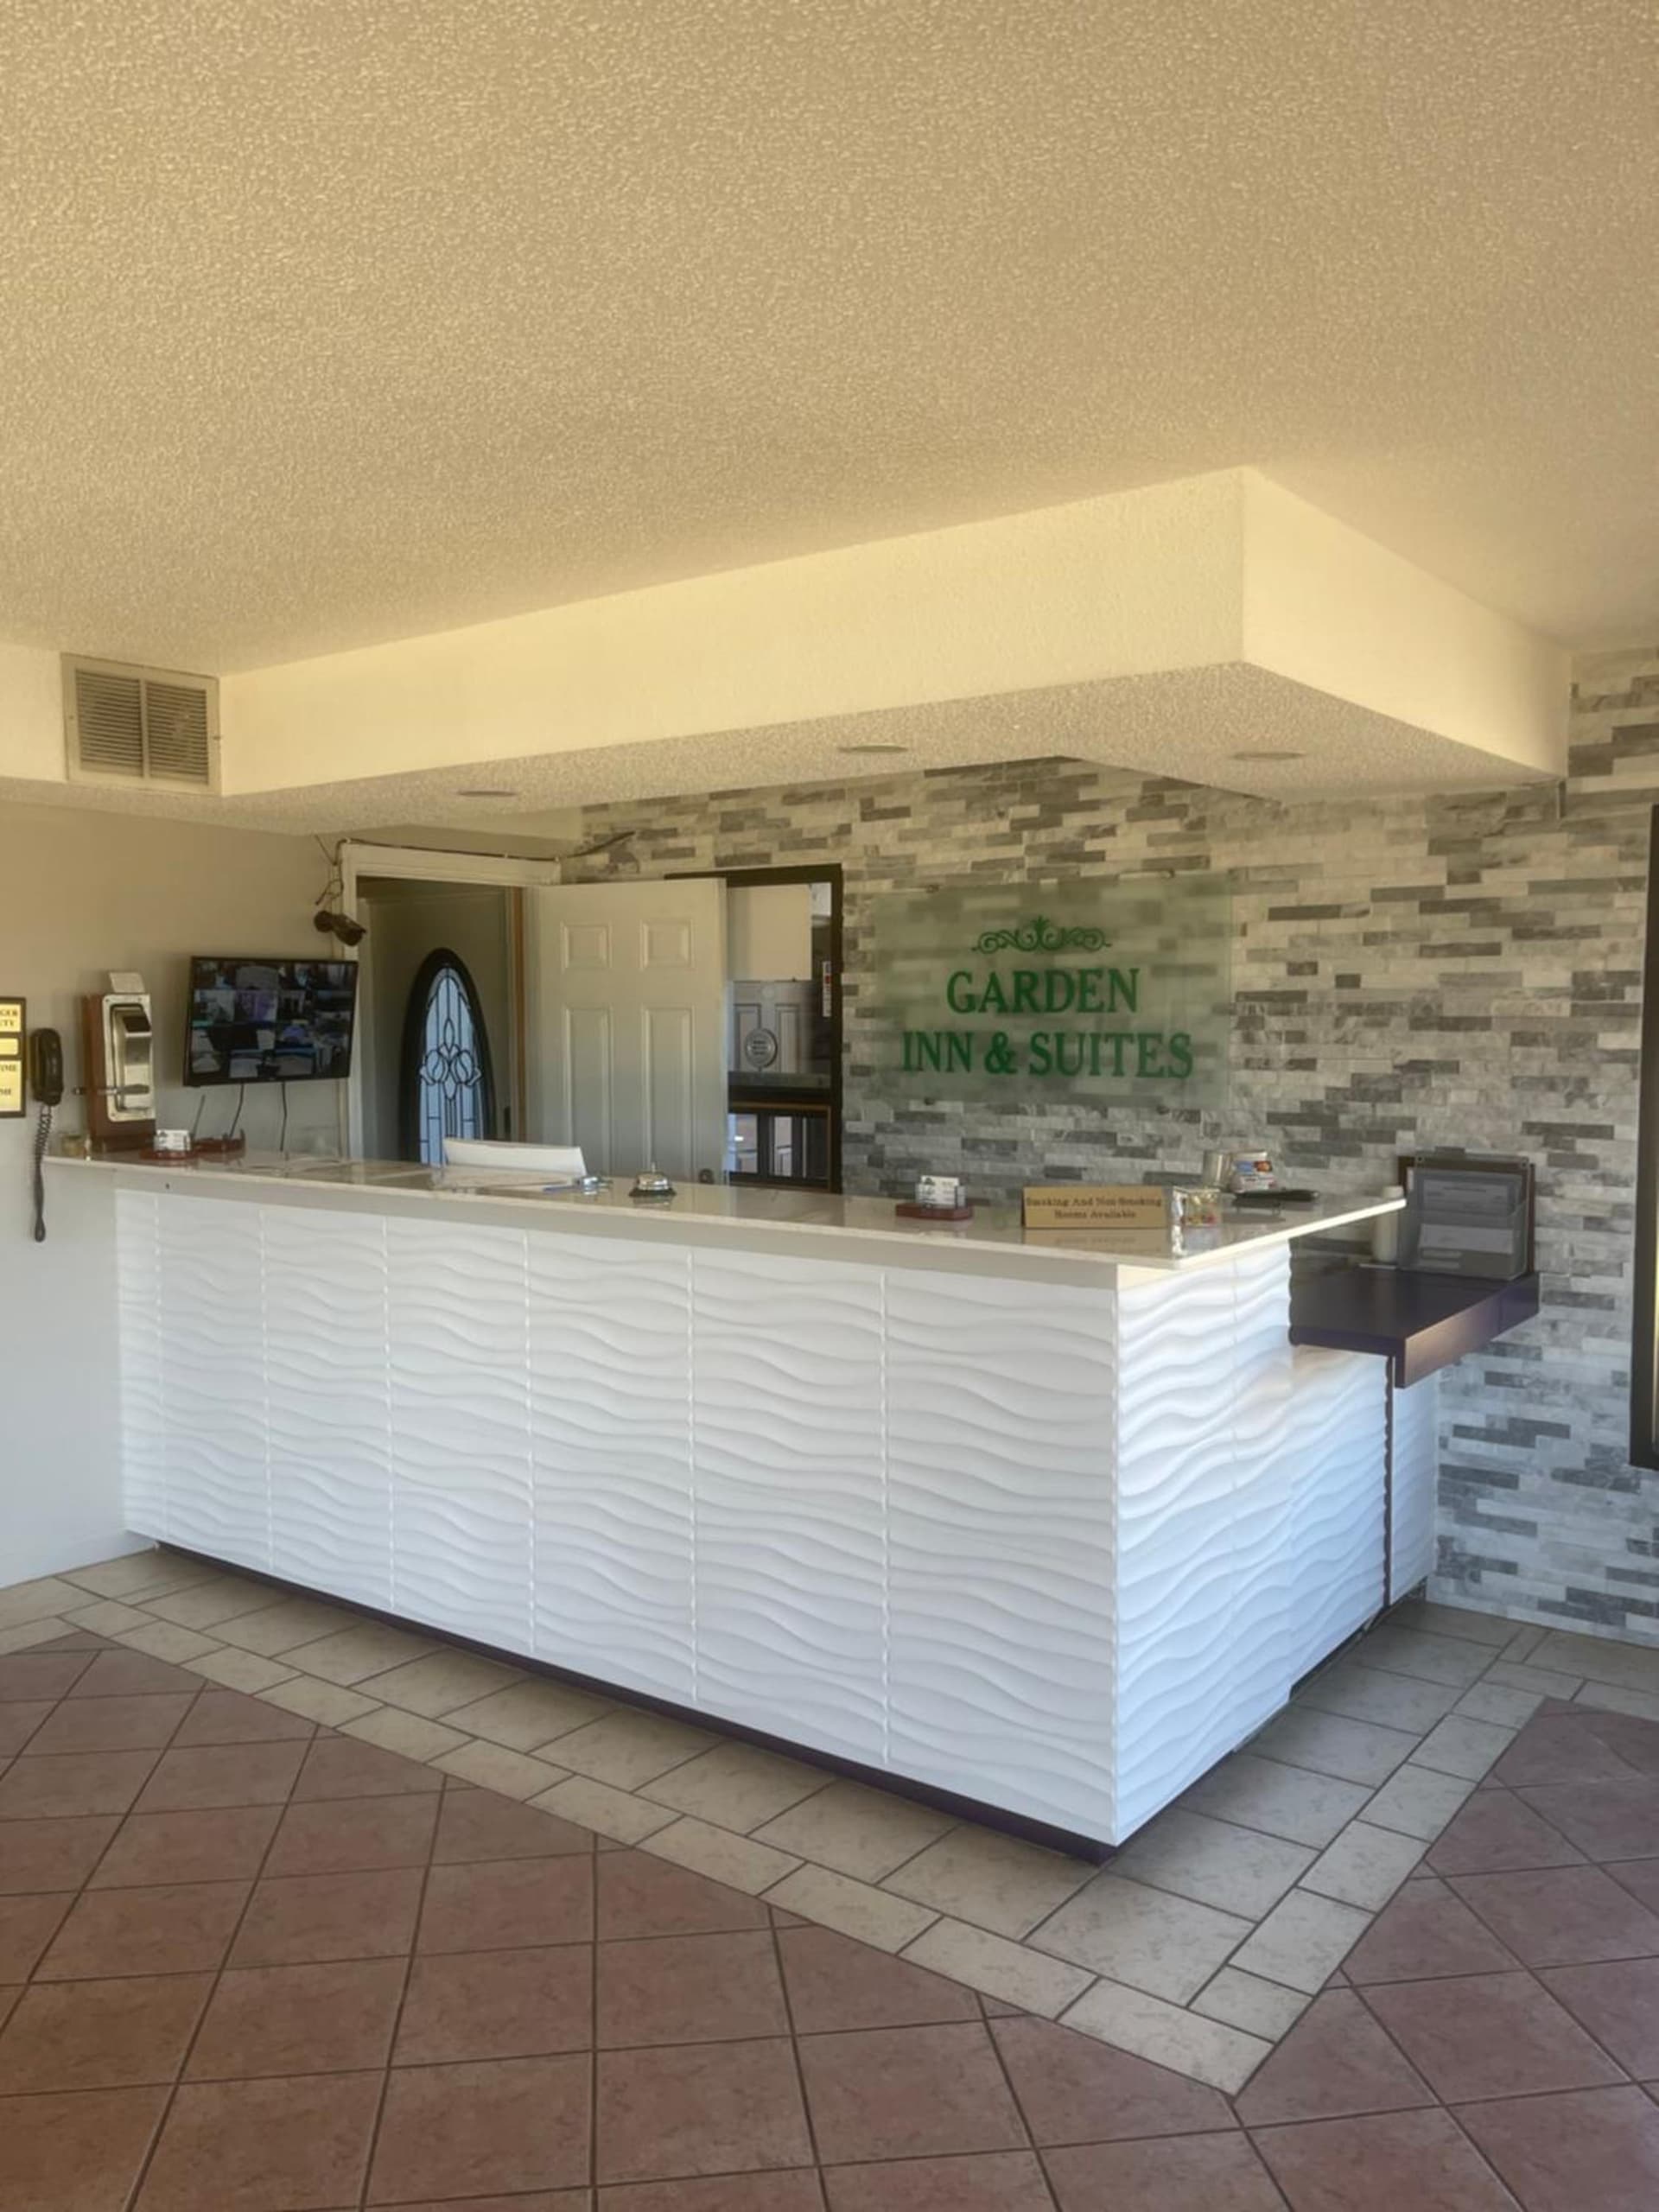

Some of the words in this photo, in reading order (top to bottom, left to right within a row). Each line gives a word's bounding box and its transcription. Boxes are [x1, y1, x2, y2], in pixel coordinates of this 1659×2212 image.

[946, 968, 1140, 1014] GARDEN
[901, 1031, 975, 1072] INN
[983, 1031, 1019, 1075] &
[1029, 1031, 1193, 1078] SUITES
[1027, 1197, 1069, 1207] Smoking
[1072, 1197, 1093, 1206] And
[1054, 1210, 1087, 1219] Rooms
[1090, 1209, 1136, 1219] Available
